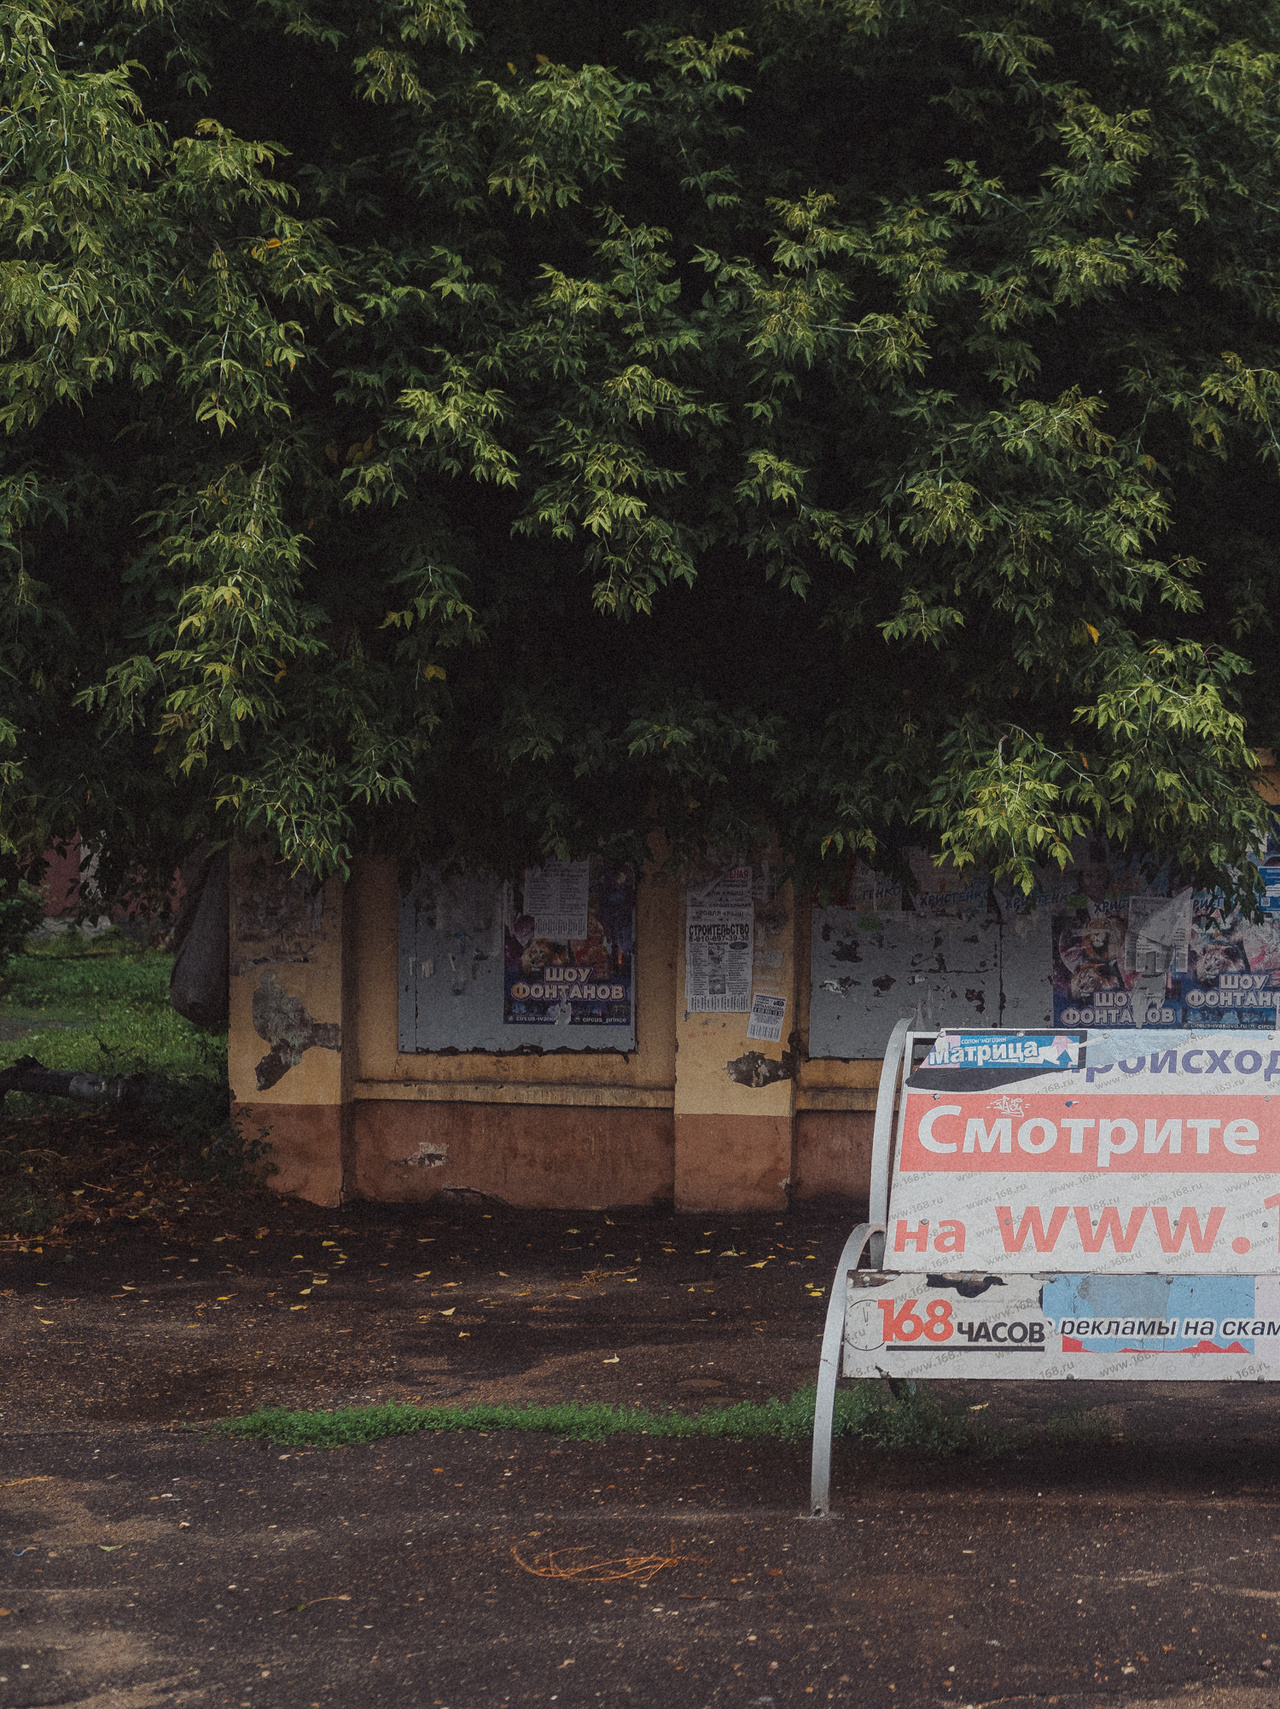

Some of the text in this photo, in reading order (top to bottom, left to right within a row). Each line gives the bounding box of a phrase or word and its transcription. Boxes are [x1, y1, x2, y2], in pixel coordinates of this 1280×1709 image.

[689, 923, 750, 936] СТРОИТЕЛЬСТВО
[544, 966, 594, 982] ШОУ
[1219, 973, 1269, 990] ШОУ
[511, 982, 626, 1001] ФОНТАНОВ
[1061, 1006, 1176, 1026] ФОНТАОВ
[928, 1041, 1039, 1066] Матрица
[1030, 1078, 1075, 1096] .168.ru
[917, 1104, 1260, 1167] Смотрите
[965, 1182, 1028, 1210] www.168.ru
[893, 1218, 967, 1254] на
[877, 1299, 1046, 1344] 168 ЧАСОВ
[1060, 1319, 1176, 1337] рекламы
[1183, 1319, 1215, 1337] на
